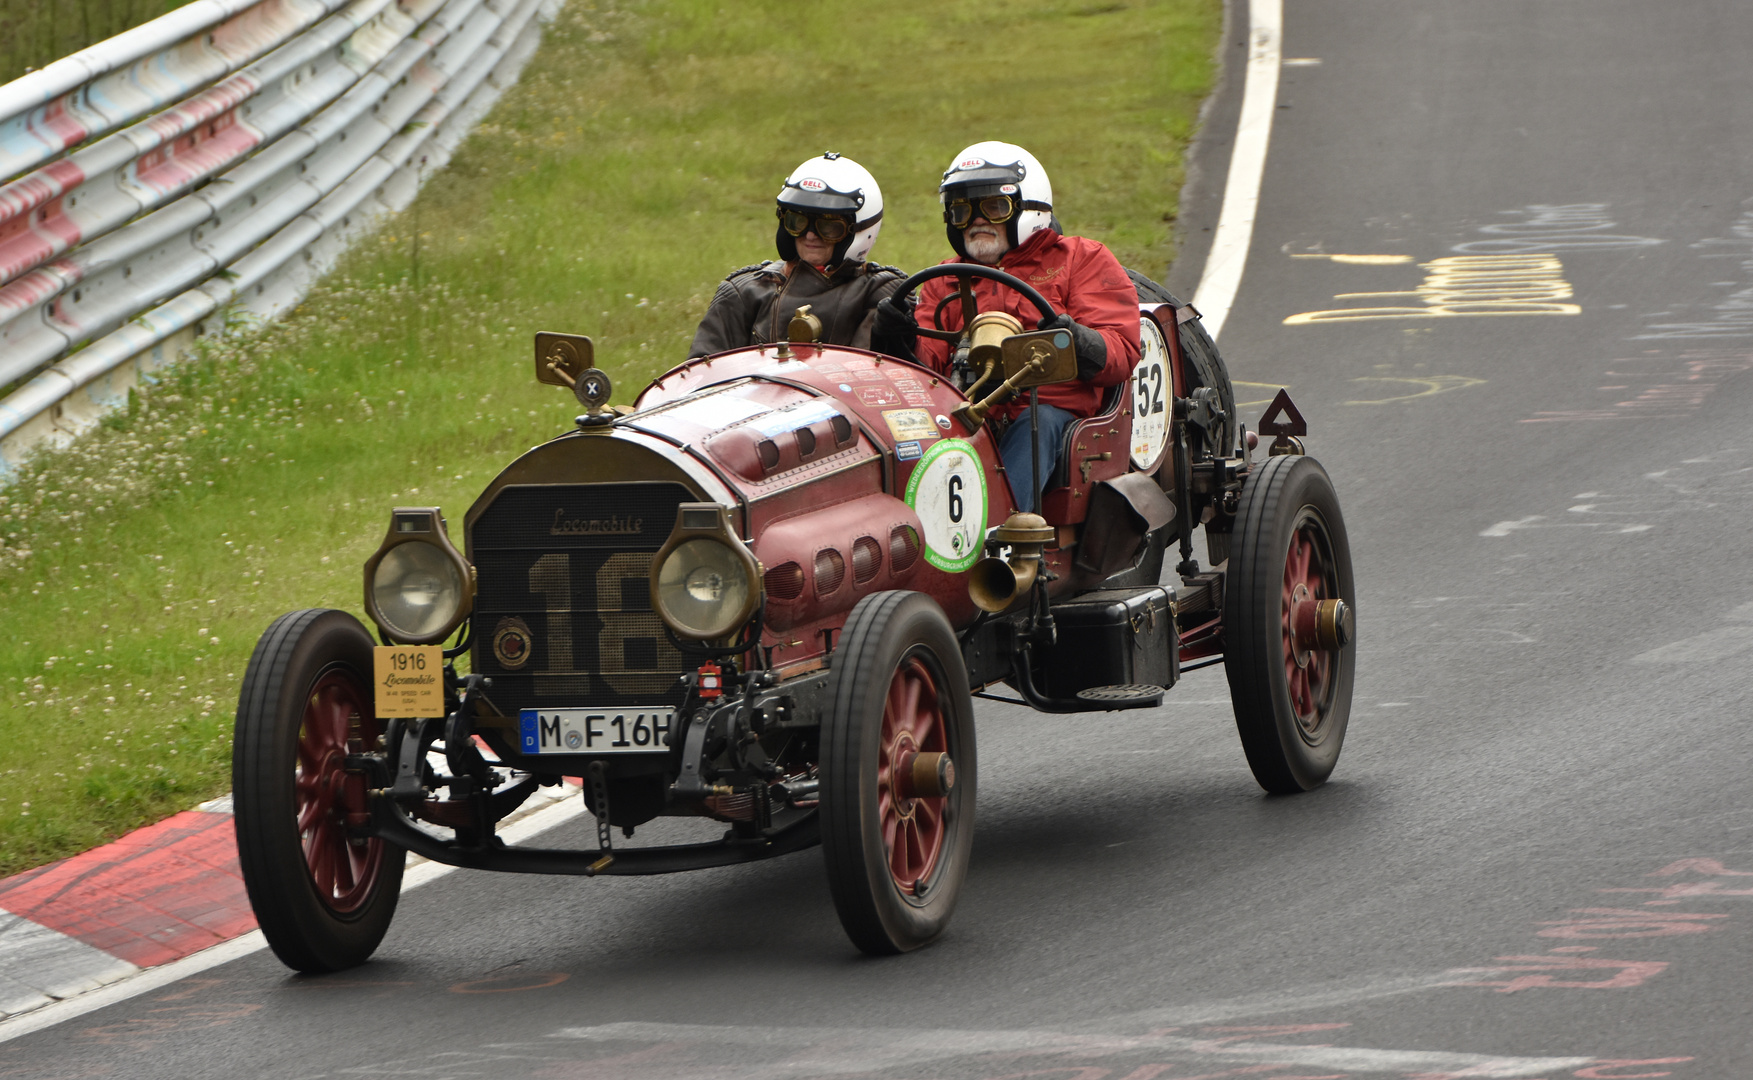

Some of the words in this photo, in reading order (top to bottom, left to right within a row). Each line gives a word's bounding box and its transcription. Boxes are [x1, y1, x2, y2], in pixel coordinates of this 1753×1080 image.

[802, 180, 823, 189] BELL
[1131, 363, 1164, 419] 52
[948, 474, 963, 524] 6
[550, 508, 643, 535] Locomobile
[390, 653, 426, 670] 1916
[382, 672, 436, 688] Locomobile
[526, 736, 534, 746] D
[540, 714, 561, 747] M
